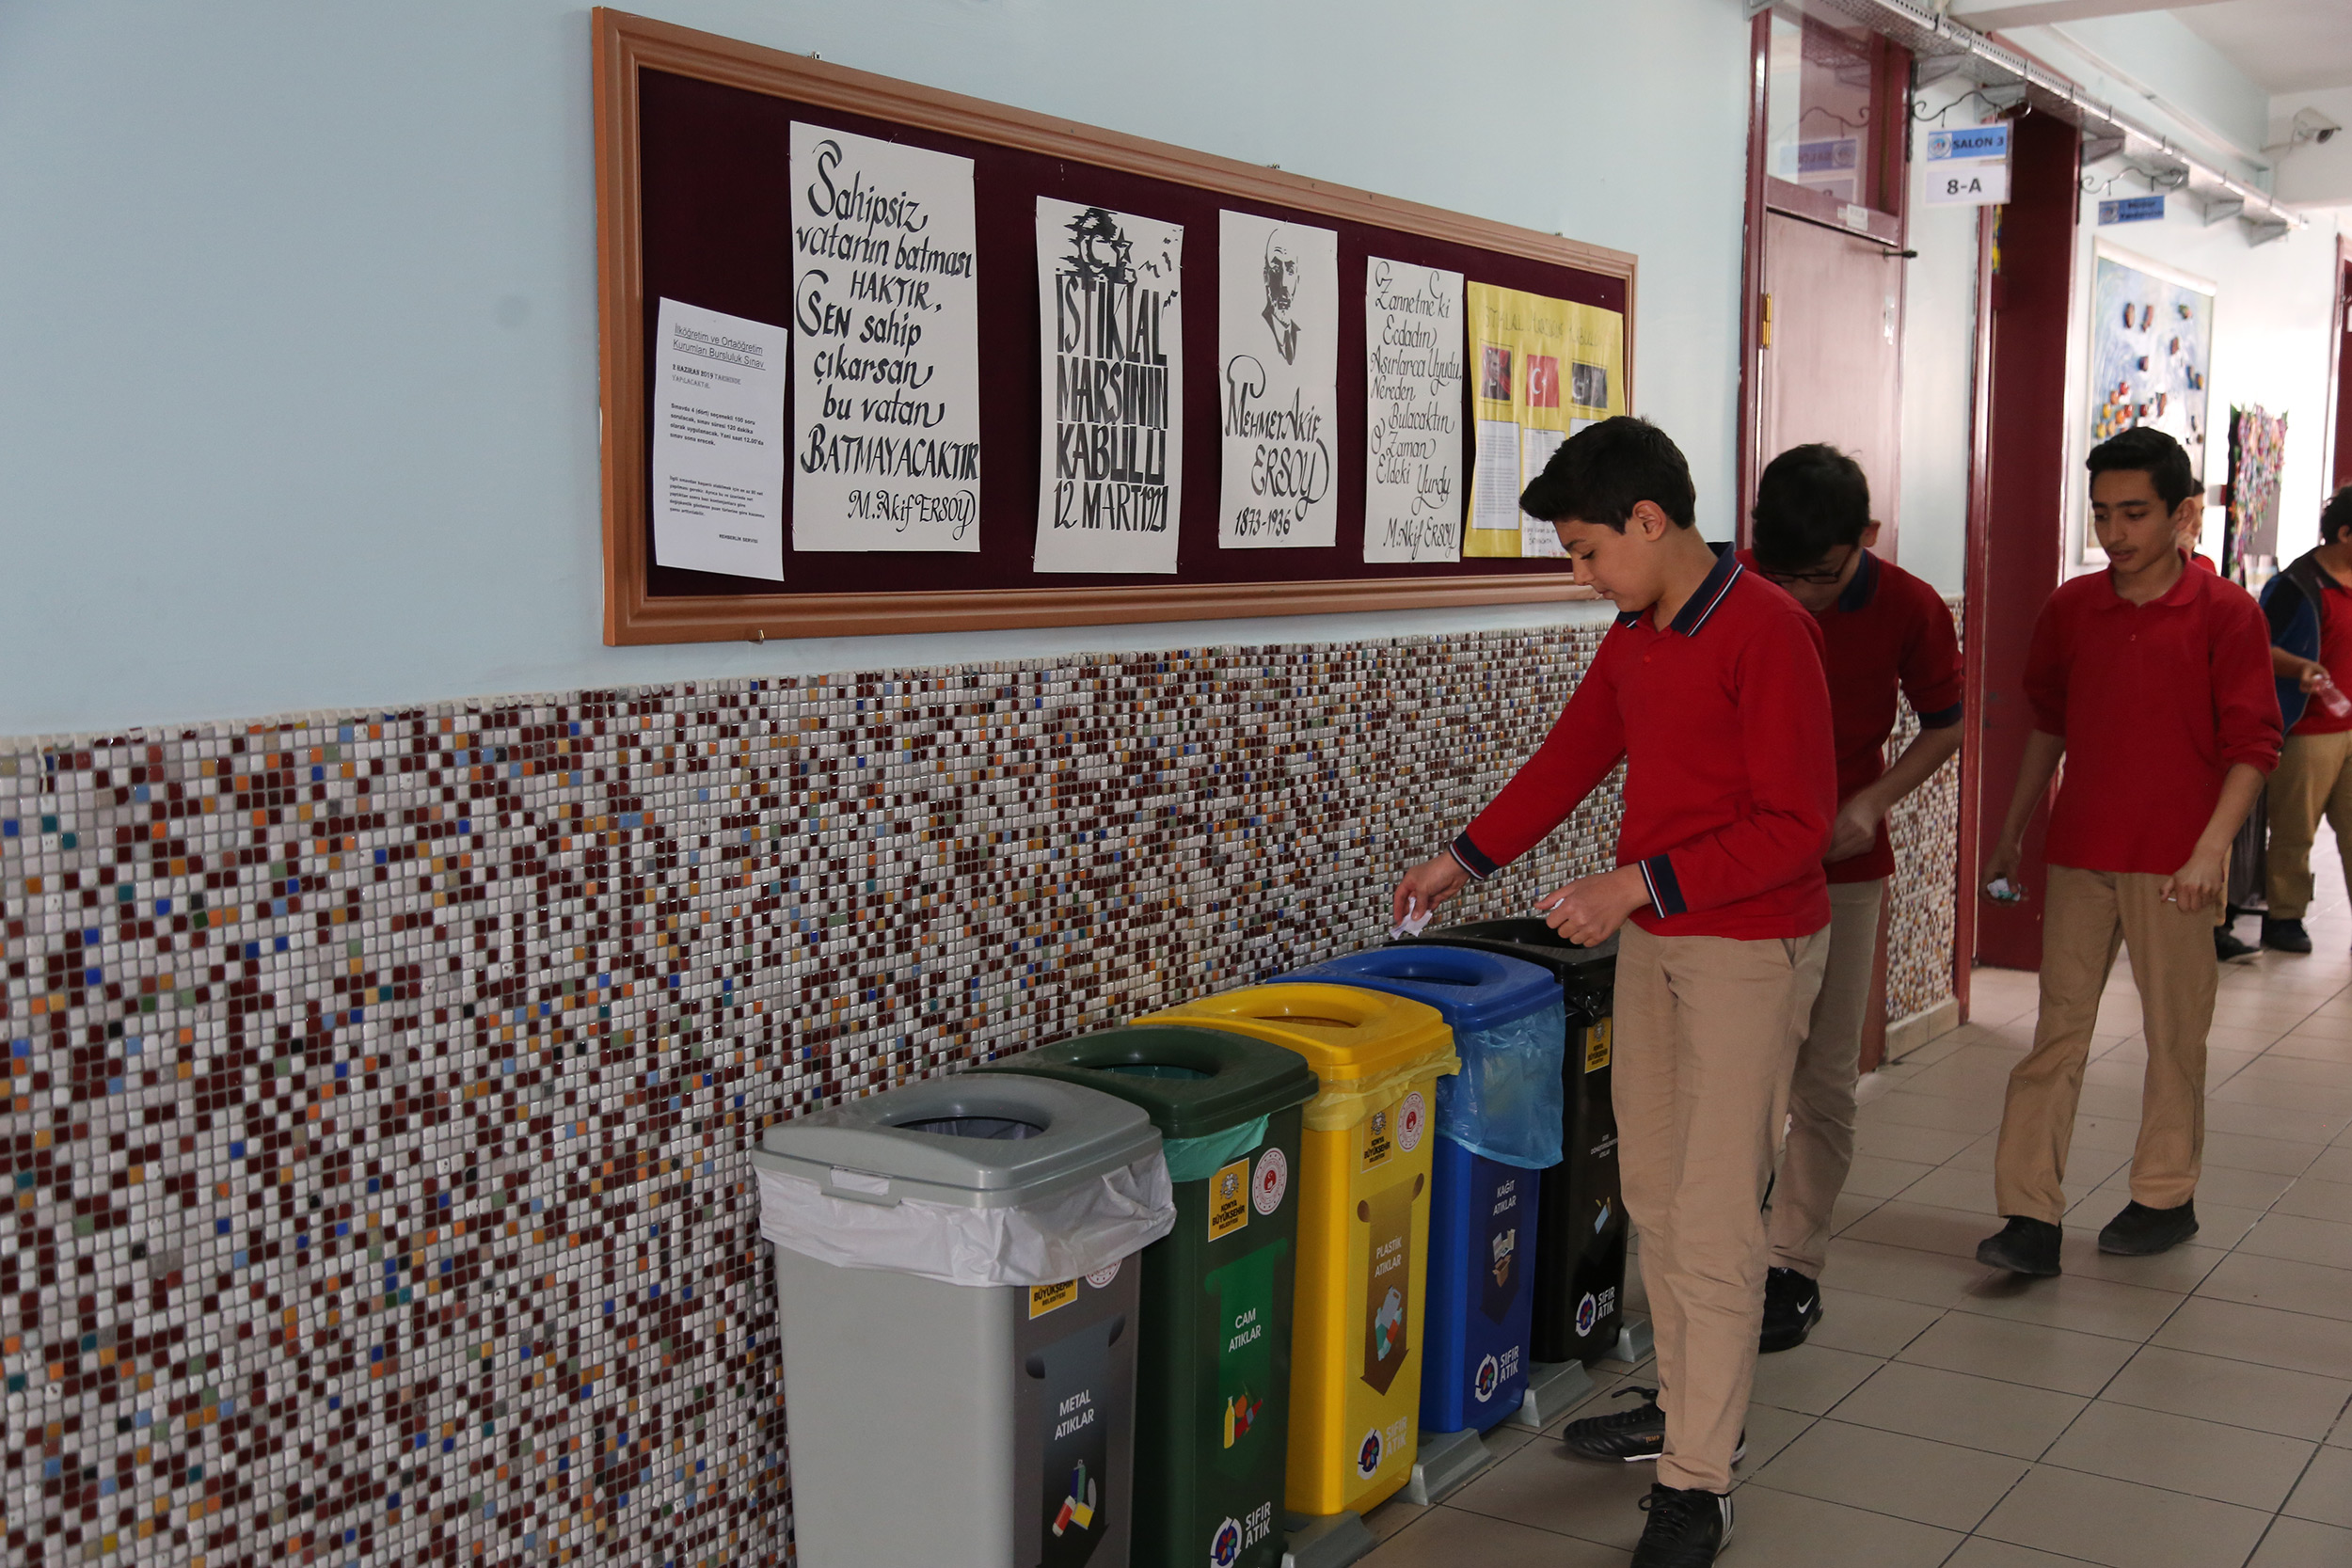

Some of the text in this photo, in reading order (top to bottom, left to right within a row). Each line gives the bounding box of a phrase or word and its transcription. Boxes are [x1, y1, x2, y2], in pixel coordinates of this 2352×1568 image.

[1953, 135, 2004, 150] SALON 3
[807, 139, 929, 236] Sahipsiz
[1947, 178, 1981, 195] 8-A
[796, 223, 973, 278] vatanın batması
[796, 269, 922, 357] SEN sahip
[673, 340, 707, 355] Kurumları
[709, 348, 742, 363] Bursluluk
[710, 336, 720, 344] ve
[722, 336, 763, 355] Ortaöğretim
[700, 370, 714, 380] 2019
[814, 343, 933, 389] çıkarsan
[822, 384, 946, 428] bu vatan
[801, 423, 978, 481] BATMAYACAKTIR
[1251, 437, 1329, 521] ERSOY
[914, 489, 976, 541] ERSOY
[1054, 480, 1077, 529] 12
[1234, 507, 1291, 536] 1873-1936
[1497, 1180, 1515, 1198] KAĞIT
[1493, 1196, 1517, 1216] ATIKLAR
[1375, 1235, 1403, 1259] PLASTİK
[1375, 1255, 1402, 1277] ATIKLAR
[1597, 1286, 1614, 1306] SIFIR
[1235, 1307, 1256, 1329] CAM
[1597, 1300, 1614, 1321] ATIK
[1229, 1324, 1262, 1353] ATIKLAR
[1500, 1345, 1519, 1368] SIFIR
[1500, 1360, 1518, 1384] ATIK
[1059, 1388, 1091, 1417] METAL
[1055, 1408, 1094, 1440] ATIKLAR
[1386, 1416, 1407, 1442] SIFIR
[1386, 1430, 1407, 1458] ATIK
[1245, 1501, 1271, 1531] SIFIR
[1245, 1517, 1271, 1549] ATIK
